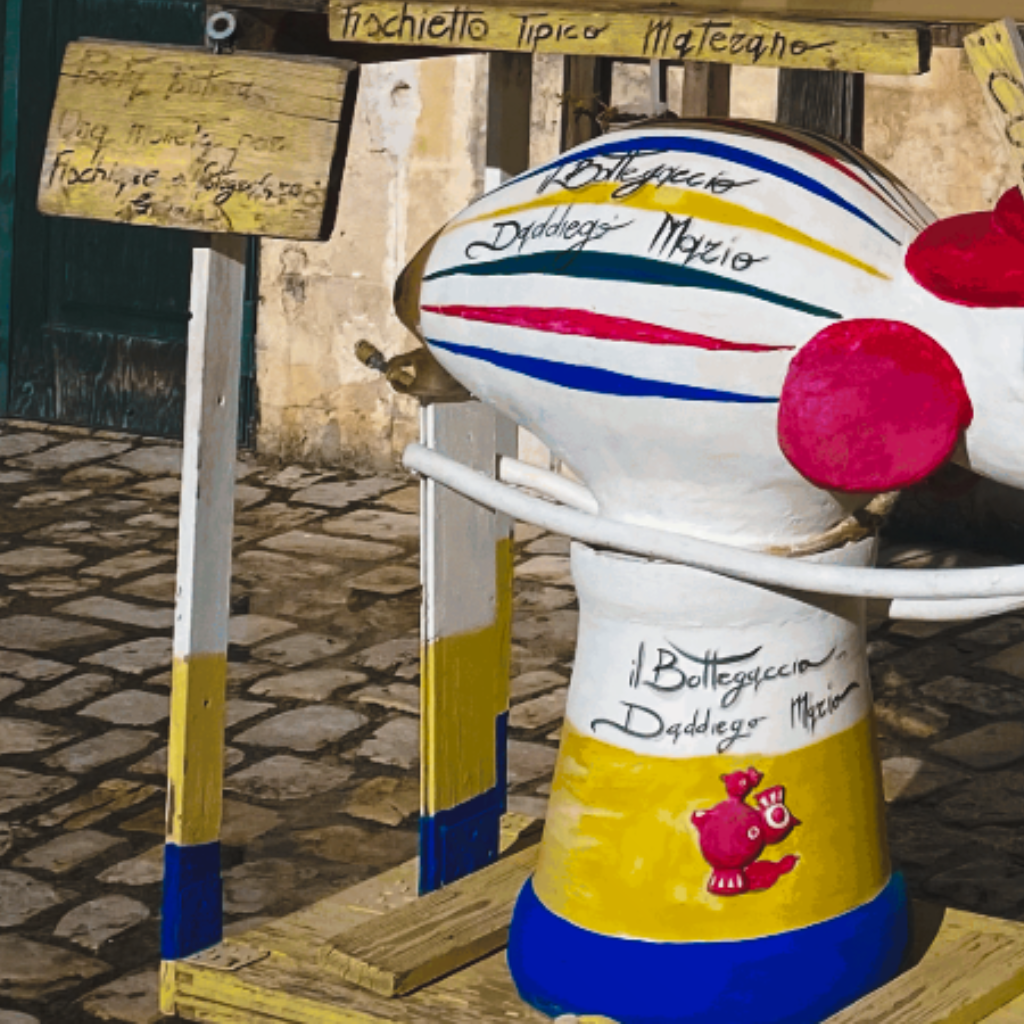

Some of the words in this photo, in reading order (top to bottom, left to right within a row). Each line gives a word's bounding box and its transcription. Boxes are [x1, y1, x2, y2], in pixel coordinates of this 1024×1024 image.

[513, 12, 609, 46] Tipico
[465, 202, 635, 269] Daddiego
[628, 641, 645, 689] il
[590, 701, 767, 754] Daddiego
